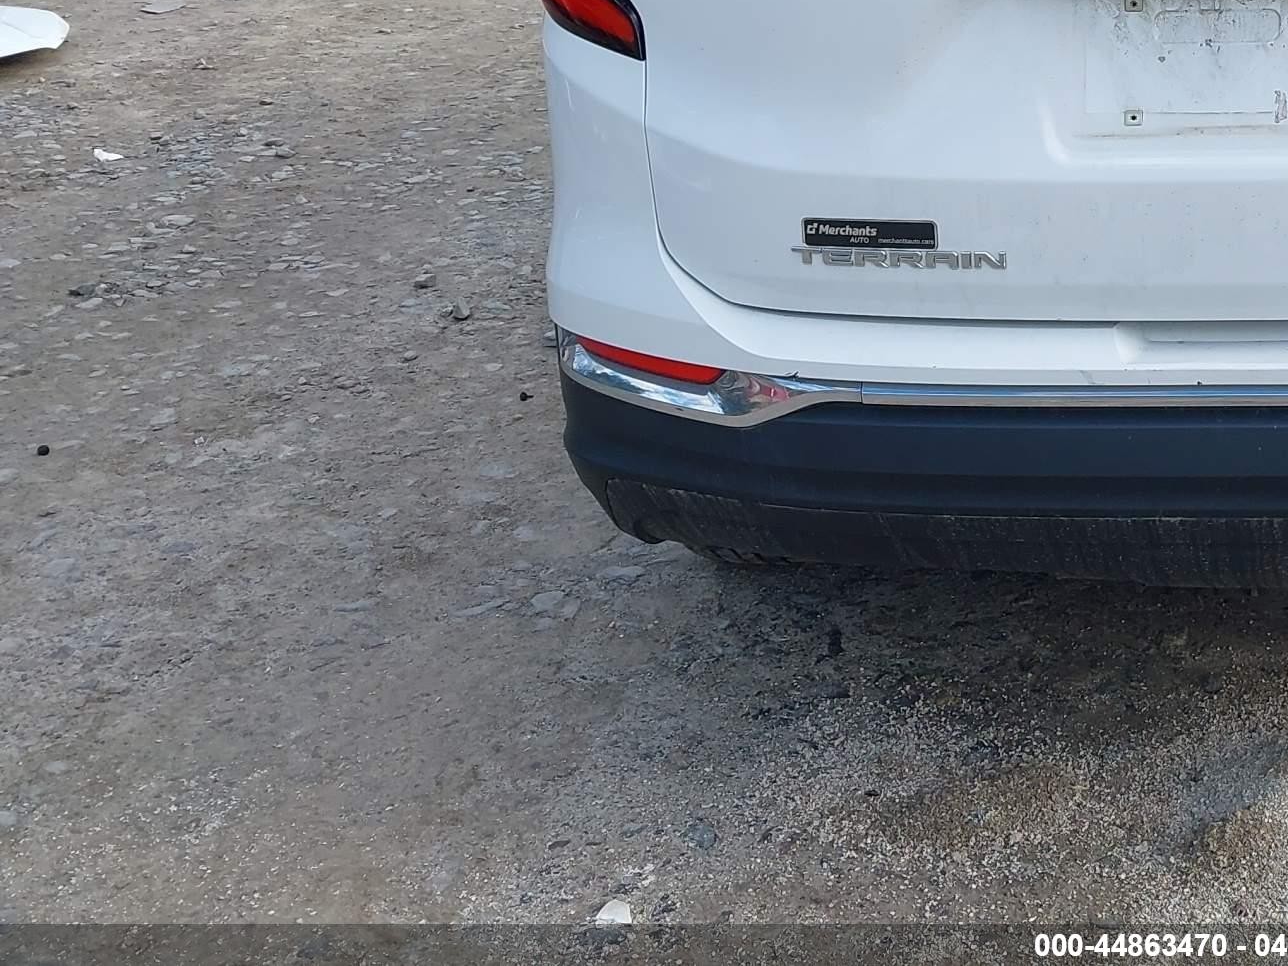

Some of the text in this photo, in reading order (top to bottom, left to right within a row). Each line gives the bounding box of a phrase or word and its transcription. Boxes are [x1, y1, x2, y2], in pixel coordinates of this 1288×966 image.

[819, 224, 877, 236] Merchants
[850, 236, 869, 244] AUTO
[791, 245, 1007, 270] TERRAIN
